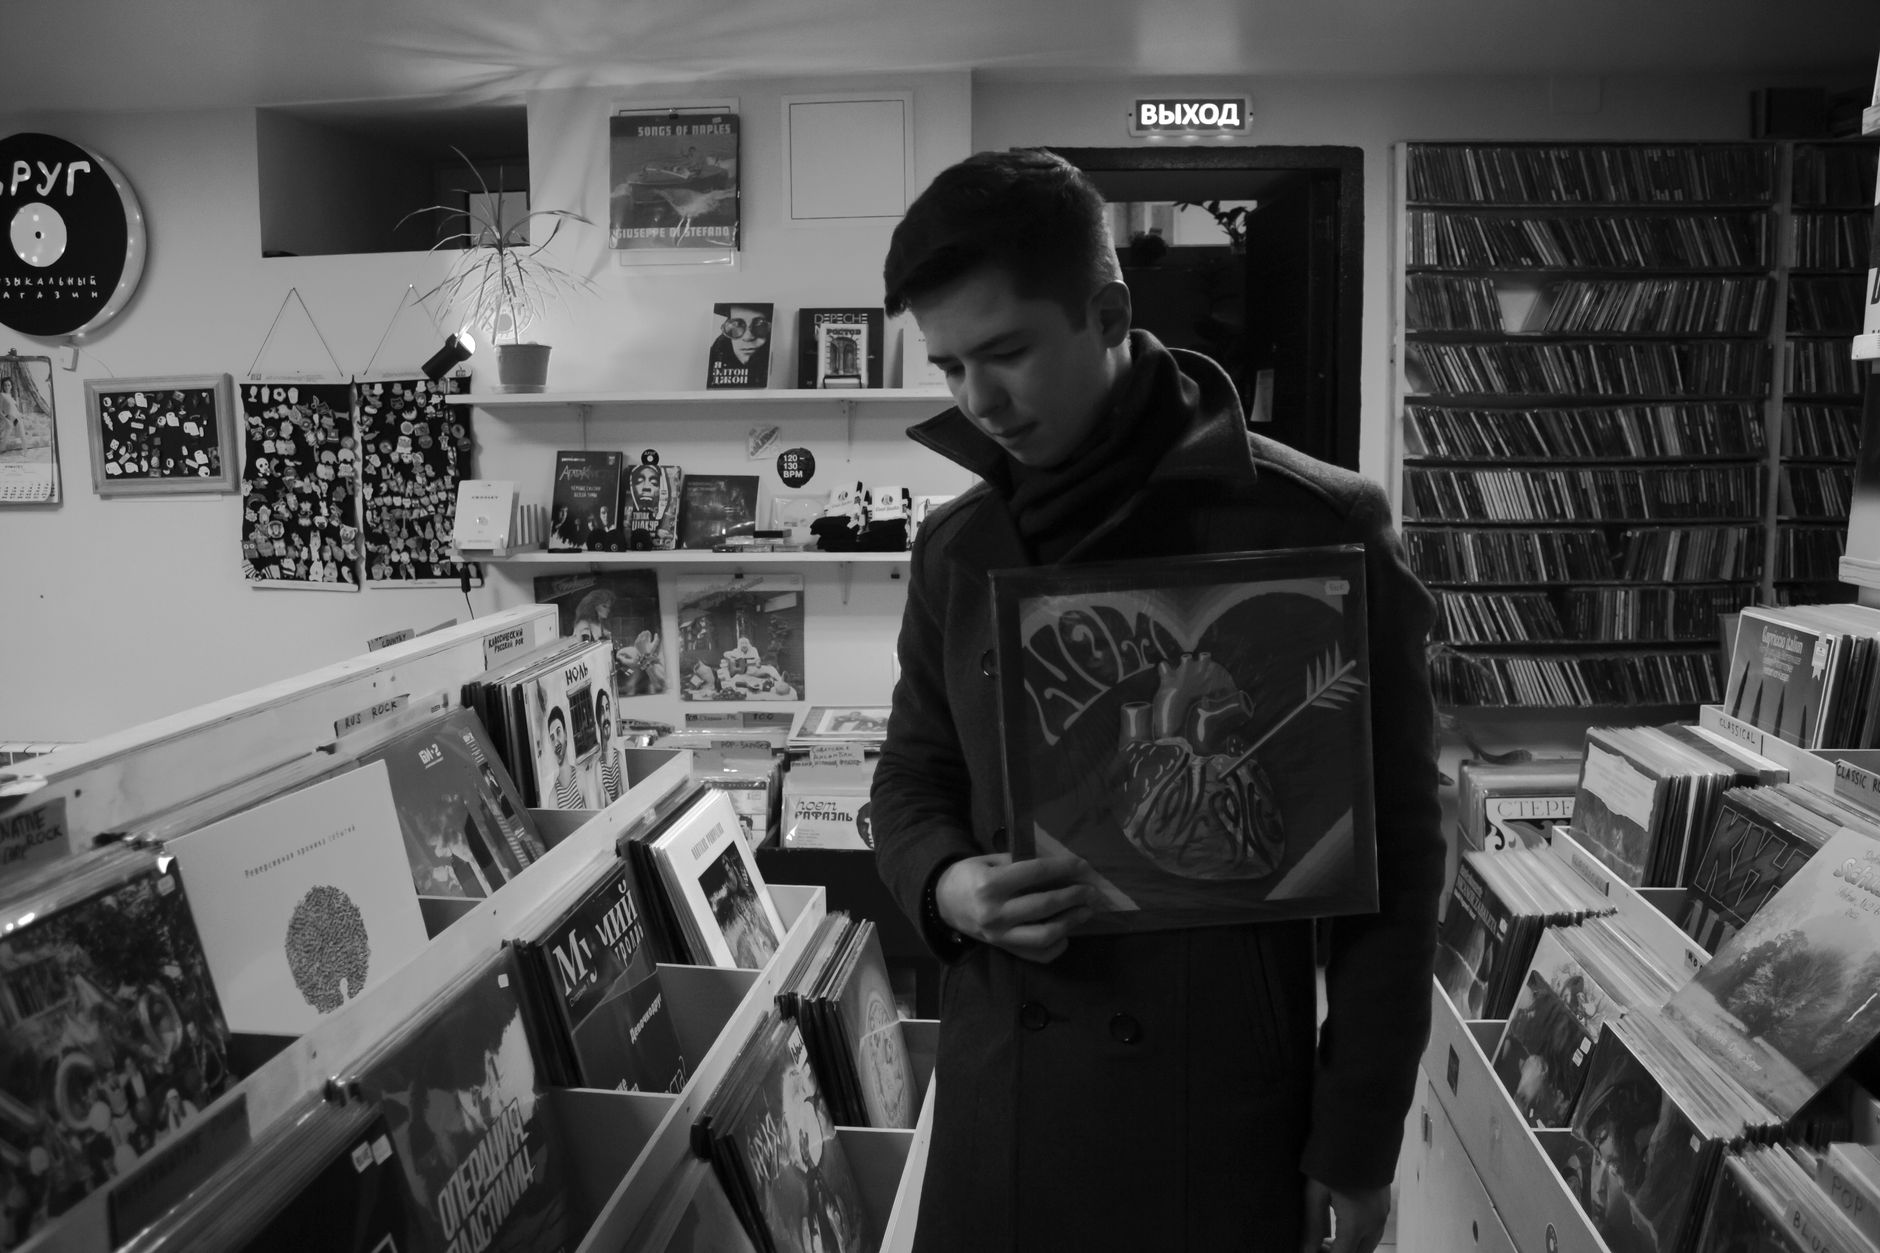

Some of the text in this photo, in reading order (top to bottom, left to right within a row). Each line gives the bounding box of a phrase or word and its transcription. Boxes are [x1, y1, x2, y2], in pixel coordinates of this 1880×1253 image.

[1140, 103, 1240, 127] ВЫХОД
[637, 124, 731, 137] SONGS OF NAPLES
[0, 160, 91, 197] РУГ
[616, 228, 665, 239] GIUSEPPE
[684, 226, 730, 238] STEFANO
[814, 313, 868, 324] DEPECHE
[712, 368, 749, 376] ЭЛТОН
[711, 376, 749, 385] ДЖОН
[783, 454, 798, 462] 120
[783, 462, 798, 470] 130
[783, 470, 803, 478] BPM
[631, 520, 660, 531] ШАКУР
[565, 661, 589, 686] НОЛЬ
[345, 700, 398, 730] RUS ROCK
[1718, 715, 1756, 745] CLASSICAL
[1836, 763, 1868, 791] CLASSIC
[437, 1098, 529, 1241] ОПЕРАЦИЯ
[1832, 1173, 1866, 1219] POP
